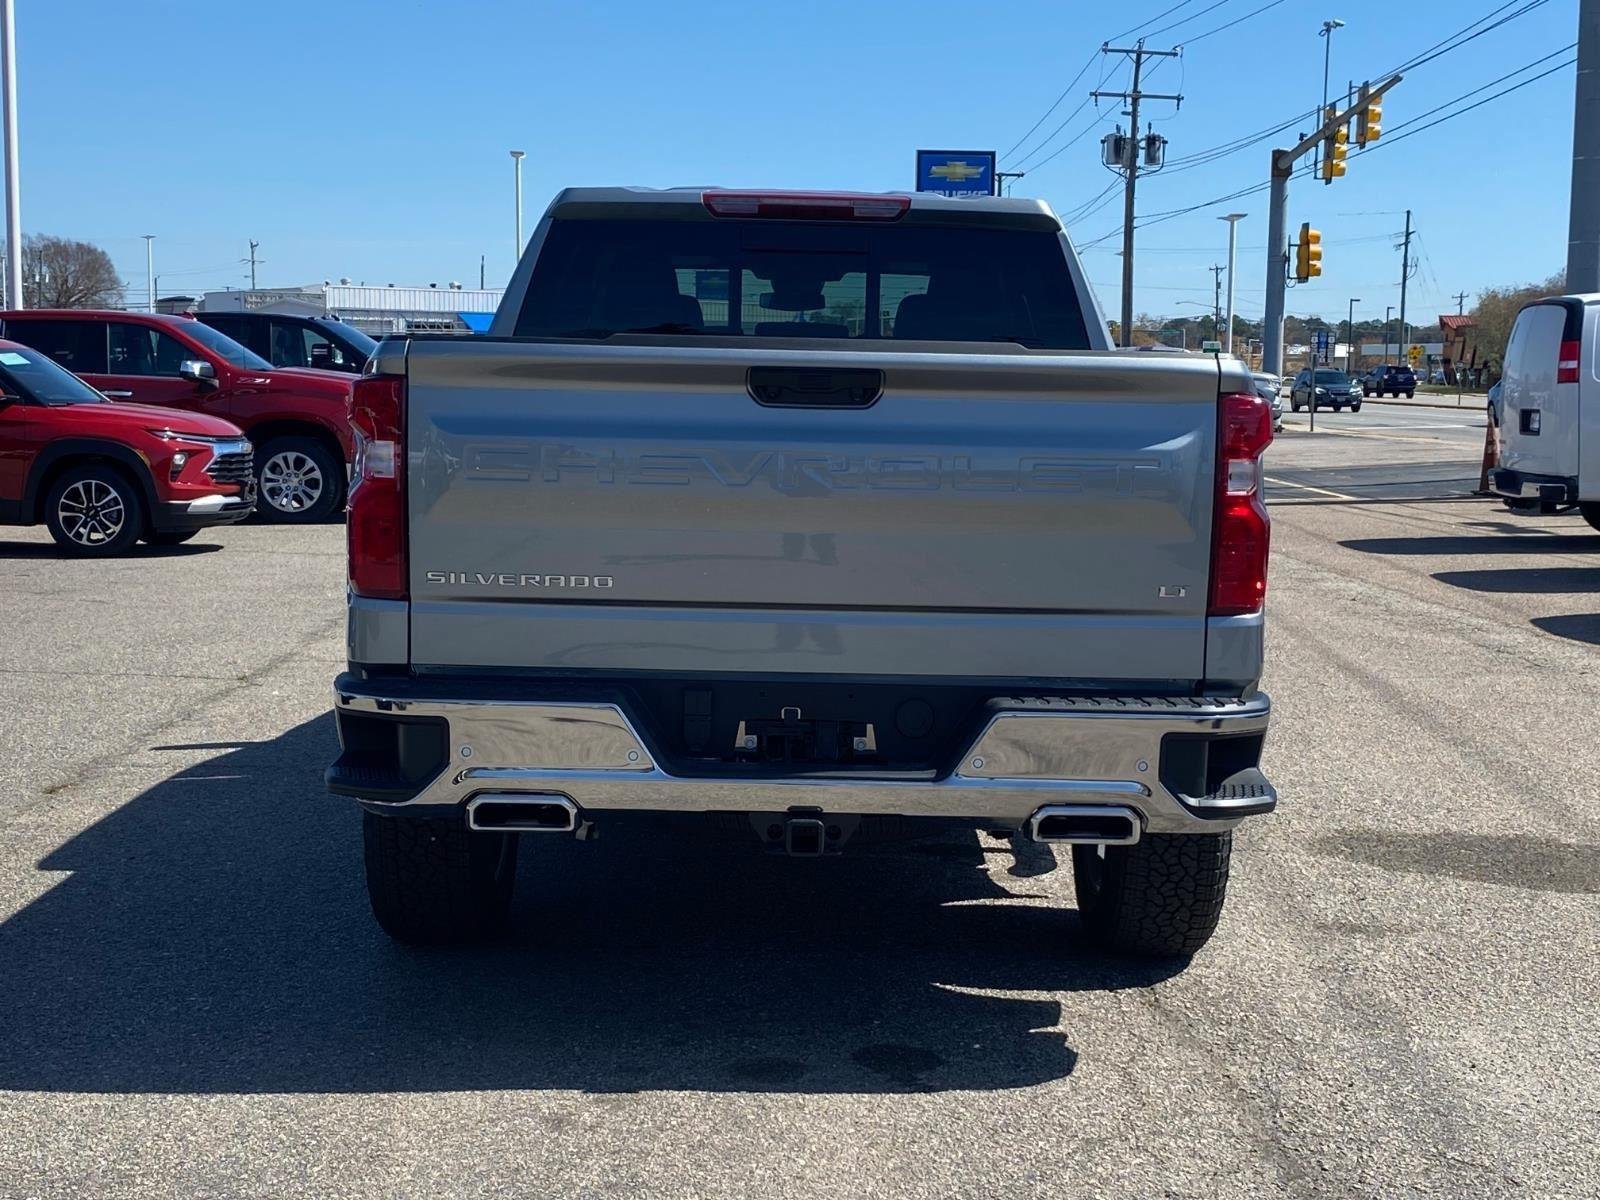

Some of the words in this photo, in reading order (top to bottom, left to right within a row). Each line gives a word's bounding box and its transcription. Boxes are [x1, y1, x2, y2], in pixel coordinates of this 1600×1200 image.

[924, 190, 988, 199] UCKS
[462, 443, 1162, 496] CHEVROLET
[425, 570, 615, 589] SILVERADO
[1158, 583, 1191, 598] LT
